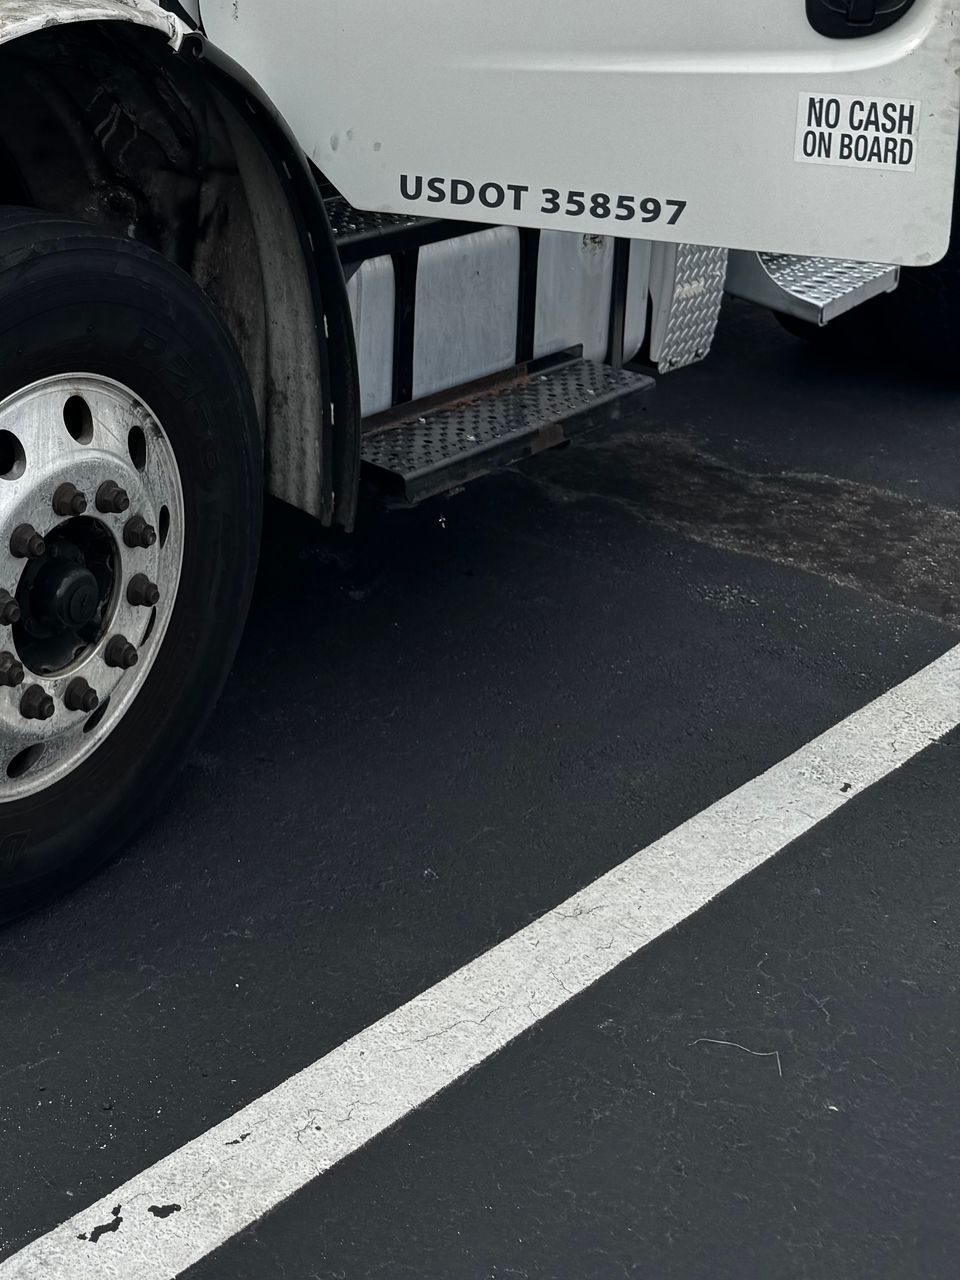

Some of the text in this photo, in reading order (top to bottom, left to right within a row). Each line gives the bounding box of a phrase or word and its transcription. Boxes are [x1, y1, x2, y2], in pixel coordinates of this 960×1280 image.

[807, 97, 914, 135] NO CASH
[803, 130, 913, 165] ON BOARD
[400, 174, 687, 225] USDOT 358597
